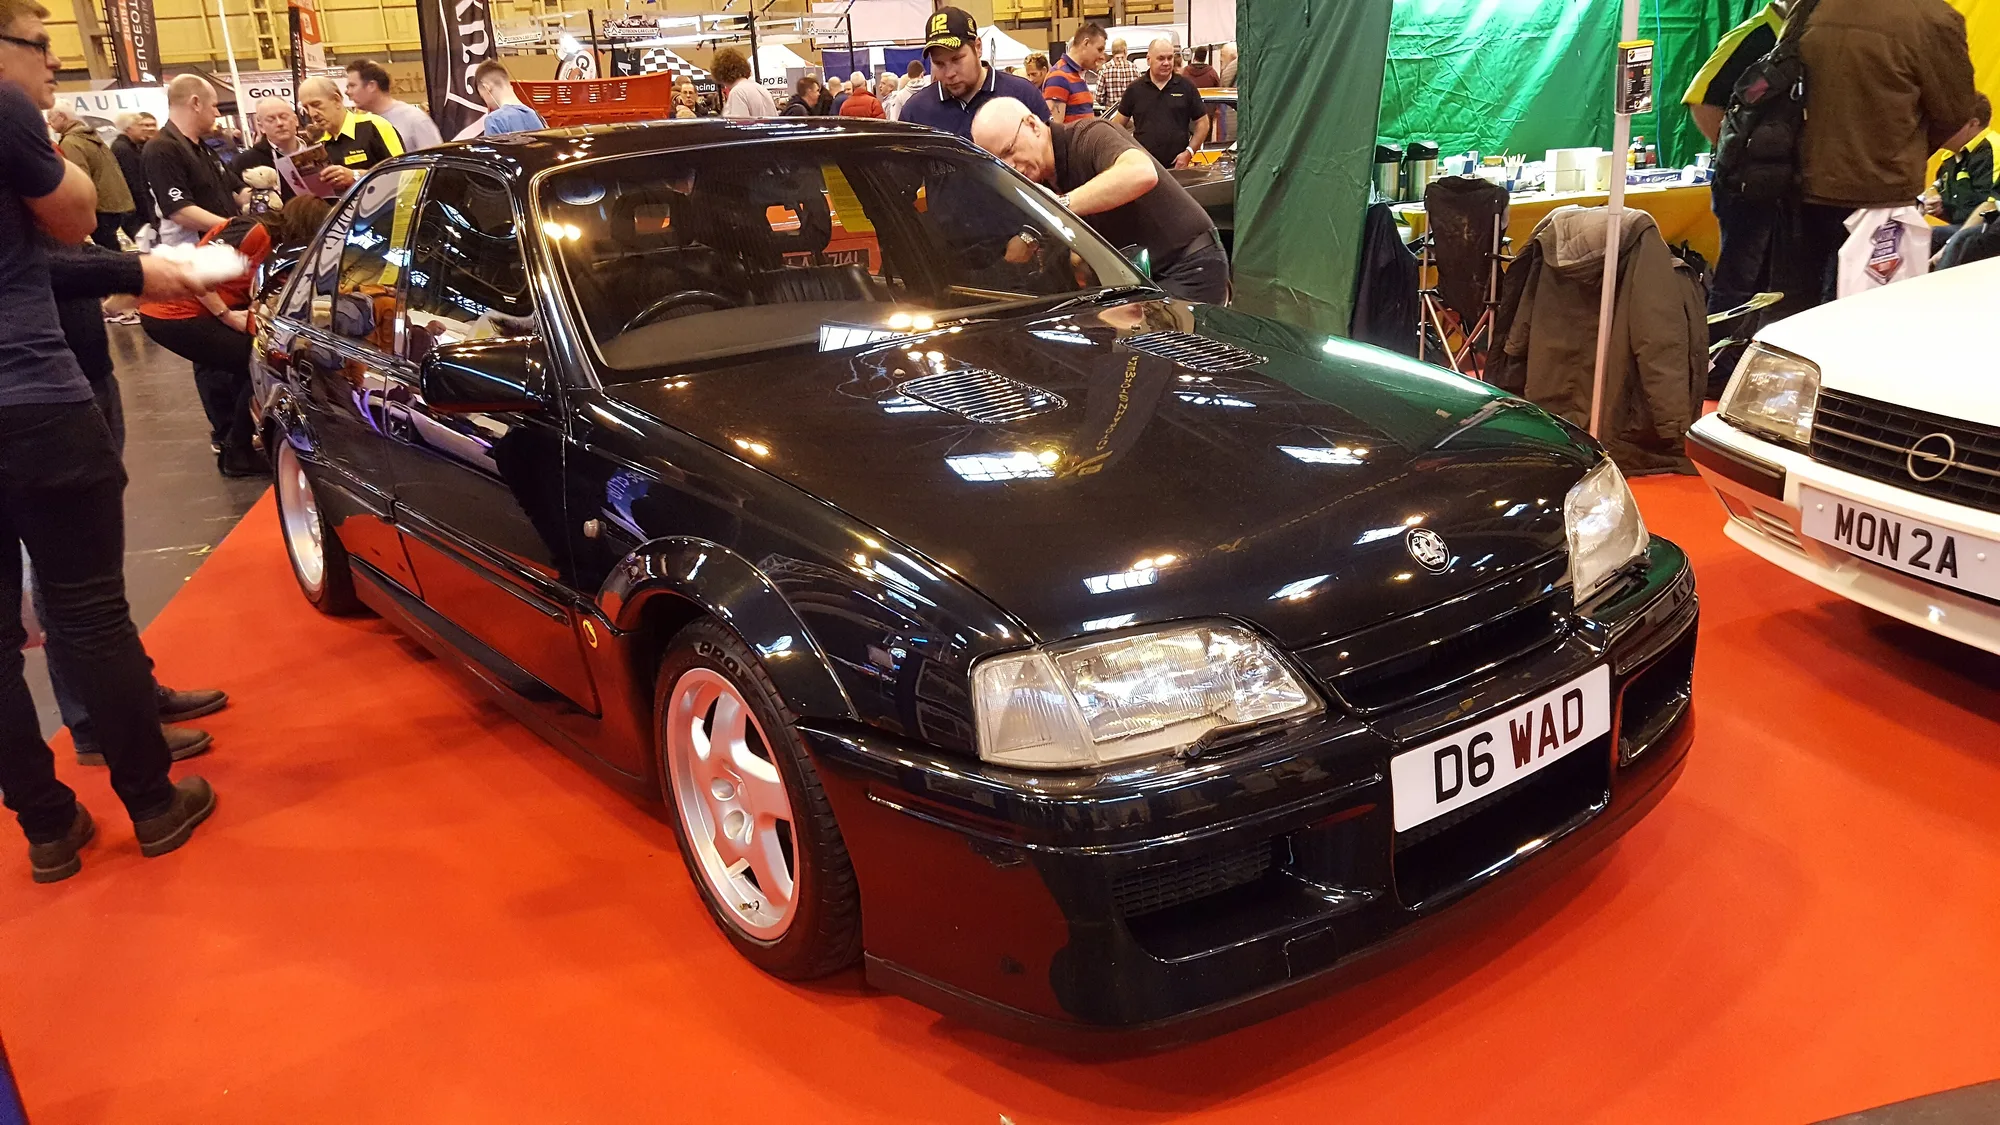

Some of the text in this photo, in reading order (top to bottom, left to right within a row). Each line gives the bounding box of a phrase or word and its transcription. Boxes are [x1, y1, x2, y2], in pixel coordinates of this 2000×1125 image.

[931, 14, 948, 32] 12
[248, 87, 292, 98] GOLD
[75, 94, 140, 112] AUL
[1834, 503, 1958, 579] MON 2A
[1434, 687, 1584, 805] D6 WAD
